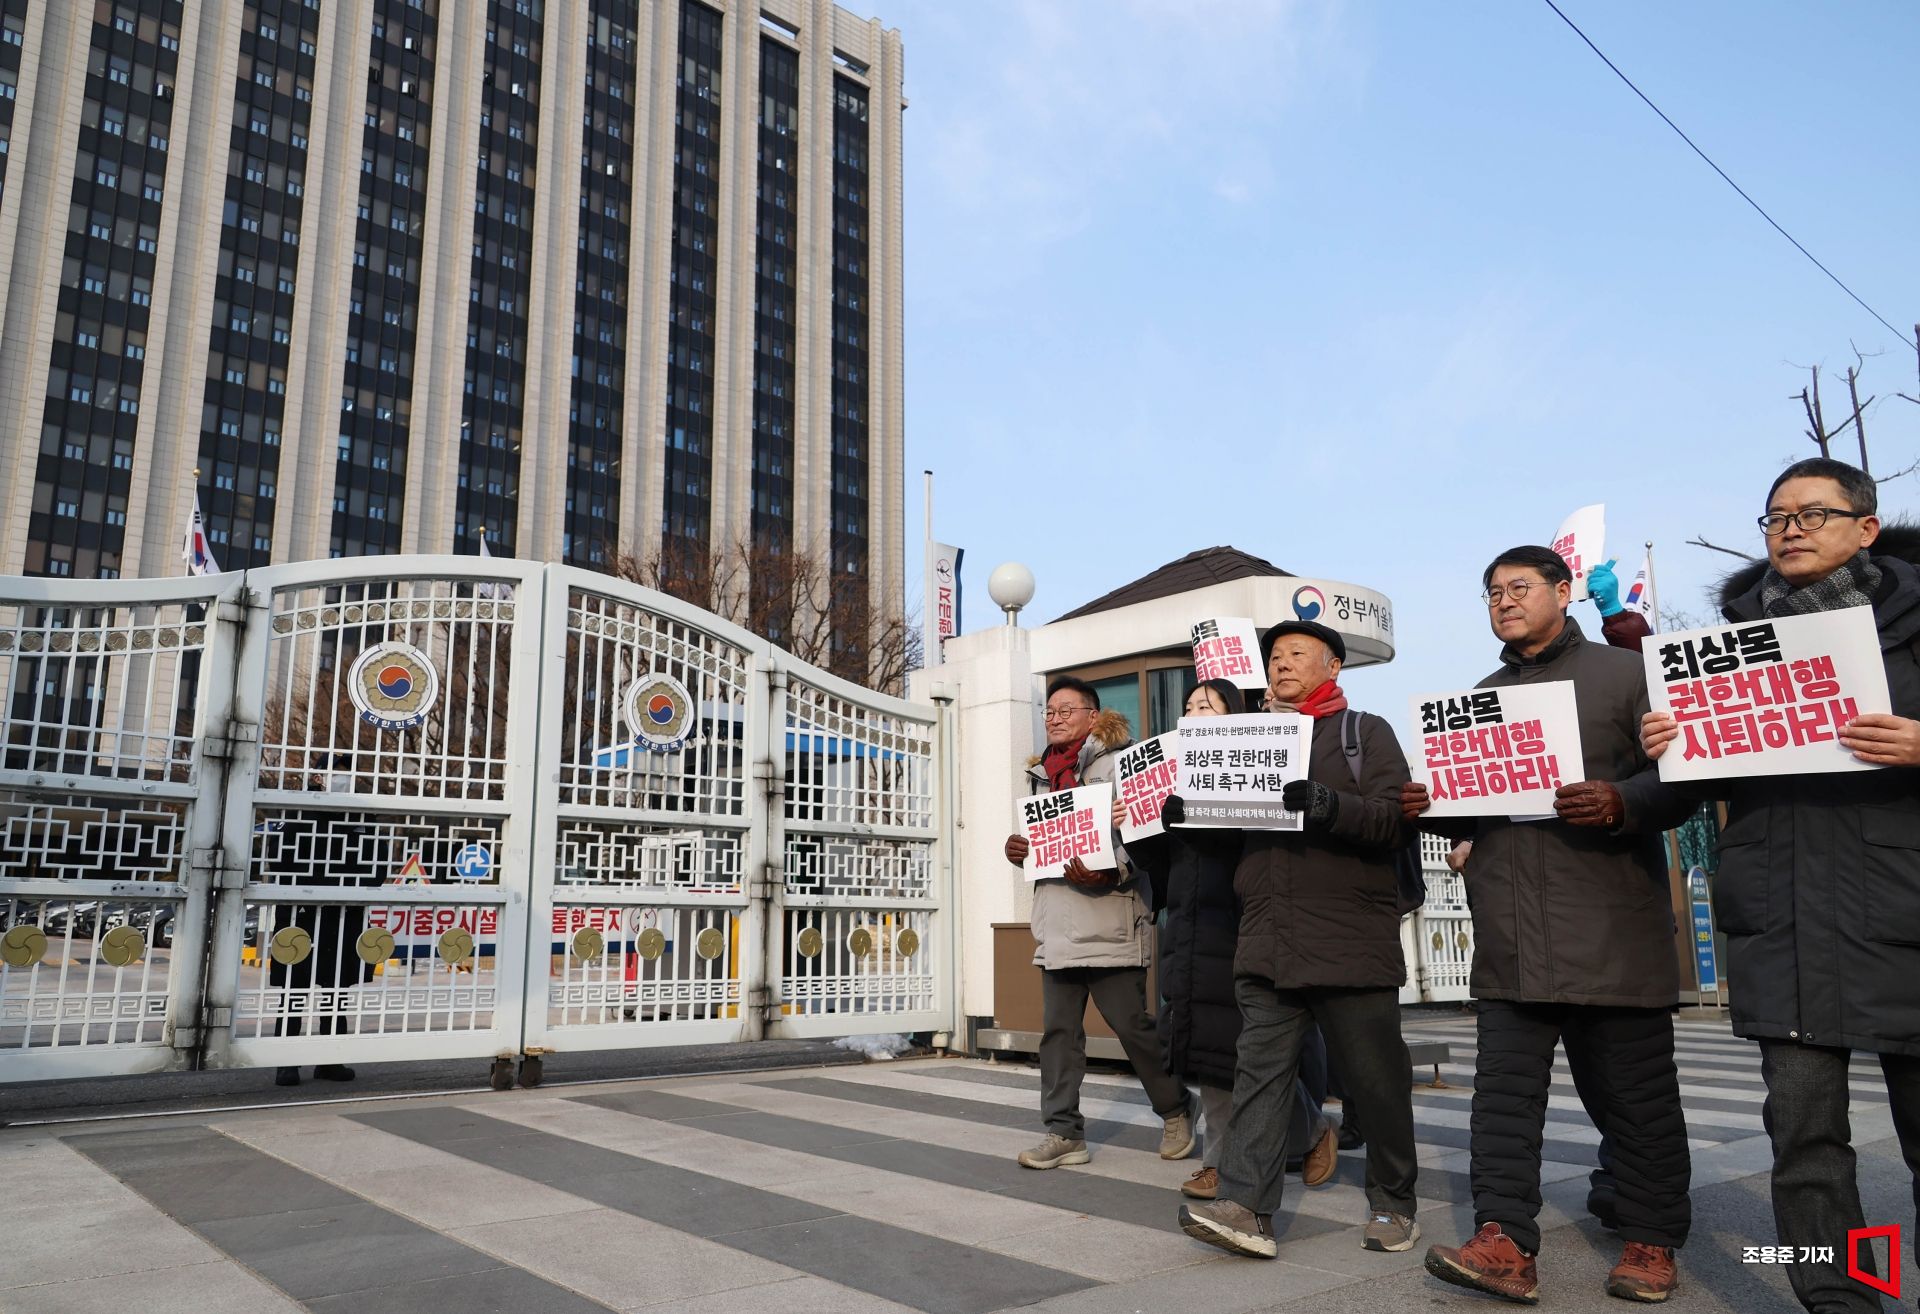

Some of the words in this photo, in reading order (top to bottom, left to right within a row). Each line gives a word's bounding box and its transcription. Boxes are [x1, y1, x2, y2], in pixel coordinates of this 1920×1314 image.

[1659, 623, 1782, 682] 최상목
[1667, 655, 1840, 722] 권한대행
[368, 715, 417, 729] 대한민국
[1195, 727, 1213, 737] 경호처
[1266, 725, 1281, 736] 선별
[1282, 724, 1298, 735] 임명
[1420, 691, 1504, 734] 최상목
[1119, 738, 1164, 781] 최상목
[1184, 749, 1224, 768] 최상목
[1227, 749, 1288, 768] 권한대행
[1424, 719, 1546, 768] 권한대행
[1188, 773, 1215, 791] 사퇴
[1218, 773, 1248, 791] 촉구
[1251, 773, 1282, 791] 서한
[1431, 755, 1562, 801] 사퇴하라!
[1024, 791, 1074, 824] 최상목
[1195, 807, 1210, 818] 즉각
[1211, 807, 1226, 818] 퇴진
[1227, 808, 1266, 819] 사회대개혁
[1028, 808, 1094, 847] 권한대행
[1035, 830, 1101, 868] 사퇴하라!
